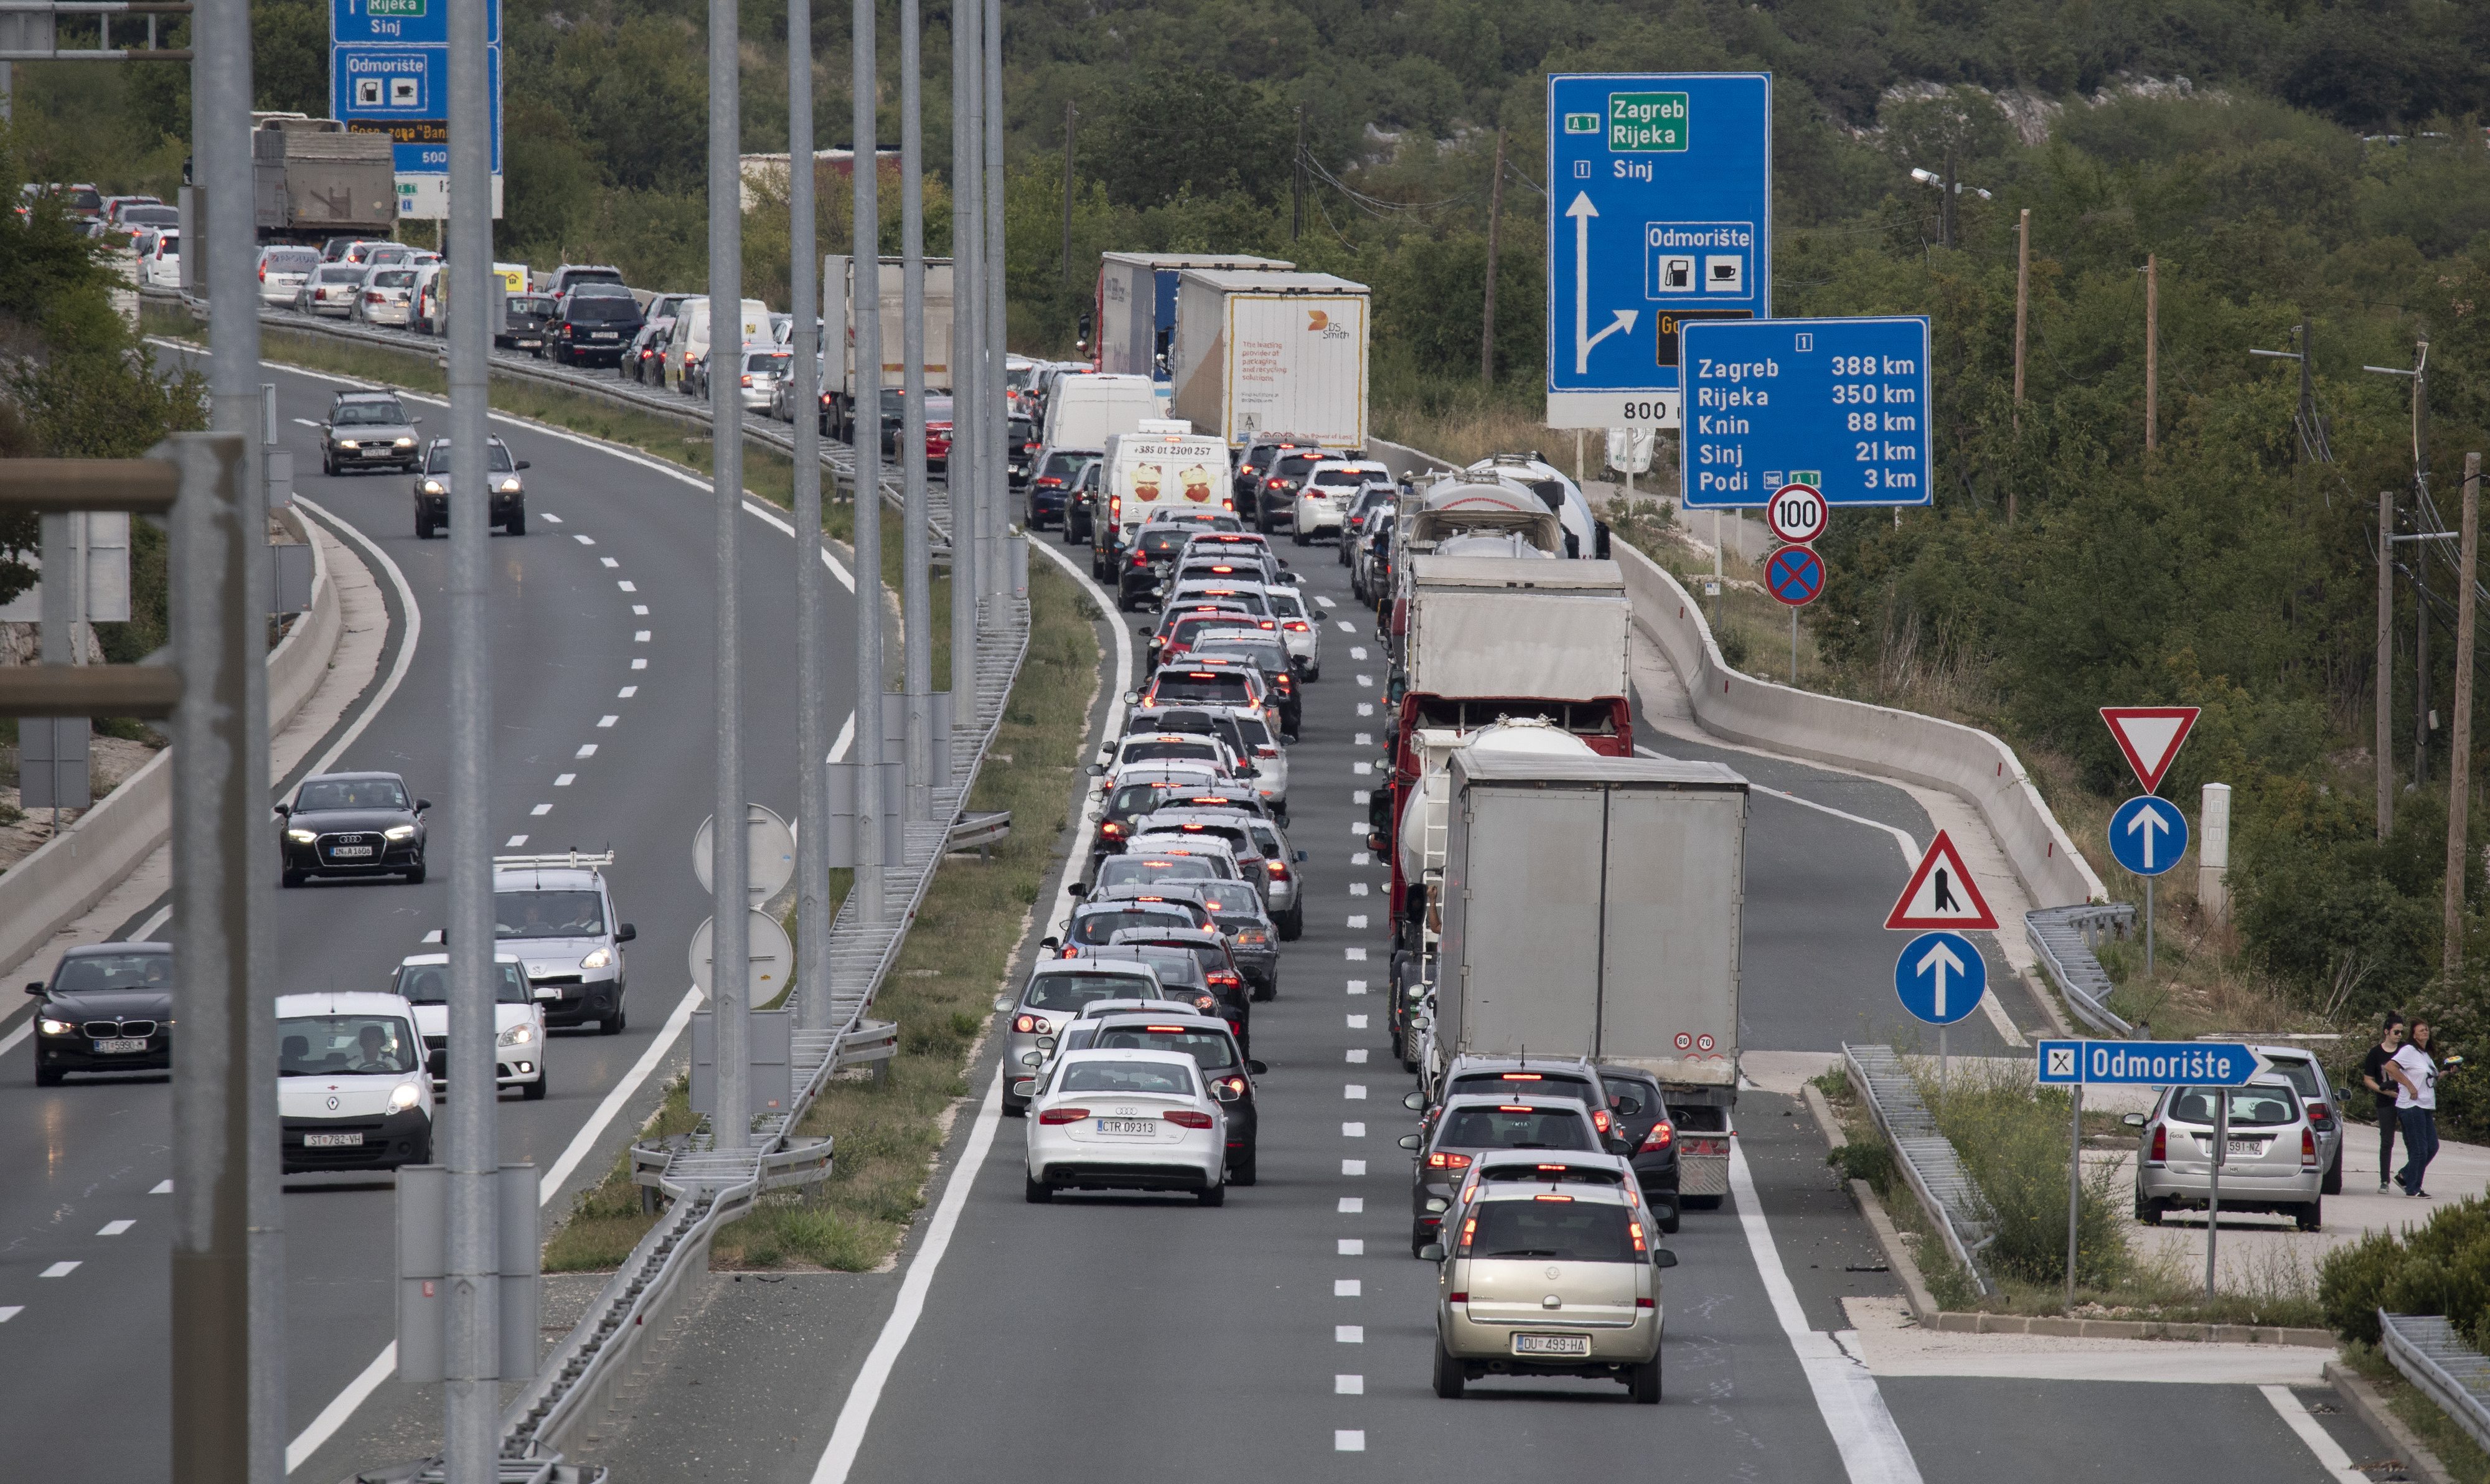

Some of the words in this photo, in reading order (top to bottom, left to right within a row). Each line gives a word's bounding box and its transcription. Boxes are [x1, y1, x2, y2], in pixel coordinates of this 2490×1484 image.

[370, 0, 416, 13] Rijeka
[371, 19, 401, 36] Sinj
[349, 59, 424, 73] Odmorište
[1614, 100, 1684, 124] Zagreb
[1572, 118, 1579, 129] A
[1587, 118, 1592, 129] 1
[1614, 124, 1675, 148] Rijeka
[422, 151, 447, 163] 500
[1579, 163, 1585, 174] 1
[1614, 160, 1653, 182] Sinj
[1650, 228, 1750, 247] Odmorište
[1328, 322, 1341, 332] DS
[1323, 330, 1350, 339] Smith
[1257, 342, 1282, 350] leading
[1801, 336, 1806, 349] 1
[1699, 358, 1779, 382] Zagreb
[1832, 356, 1877, 375] 388
[1884, 355, 1915, 375] km
[1699, 387, 1769, 411] Rijeka
[1832, 384, 1877, 404] 350
[1884, 383, 1915, 403] km
[1624, 402, 1666, 420] 800
[1699, 415, 1749, 434] Knin
[1848, 412, 1877, 432] 88
[1884, 412, 1915, 431] km
[1135, 446, 1155, 454] +385
[1157, 446, 1167, 454] 01
[1170, 446, 1193, 455] 2300
[1194, 447, 1211, 455] 257
[1700, 444, 1743, 468] Sinj
[1856, 441, 1878, 461] 21
[1884, 441, 1916, 461] km
[1700, 471, 1748, 491] Podi
[1864, 469, 1877, 489] 3
[1884, 468, 1916, 487] km
[1779, 500, 1816, 528] 100
[1678, 1037, 1688, 1045] 80
[1701, 1038, 1711, 1046] 70
[2093, 1048, 2231, 1078] Odmorište
[1103, 1121, 1121, 1132] CTR
[1124, 1122, 1153, 1133] 09313
[311, 1135, 322, 1145] ST
[328, 1135, 360, 1145] 782-VH
[2229, 1141, 2260, 1152] 591-NZ
[1525, 1338, 1538, 1350] DU
[1546, 1339, 1584, 1351] 499-HA
